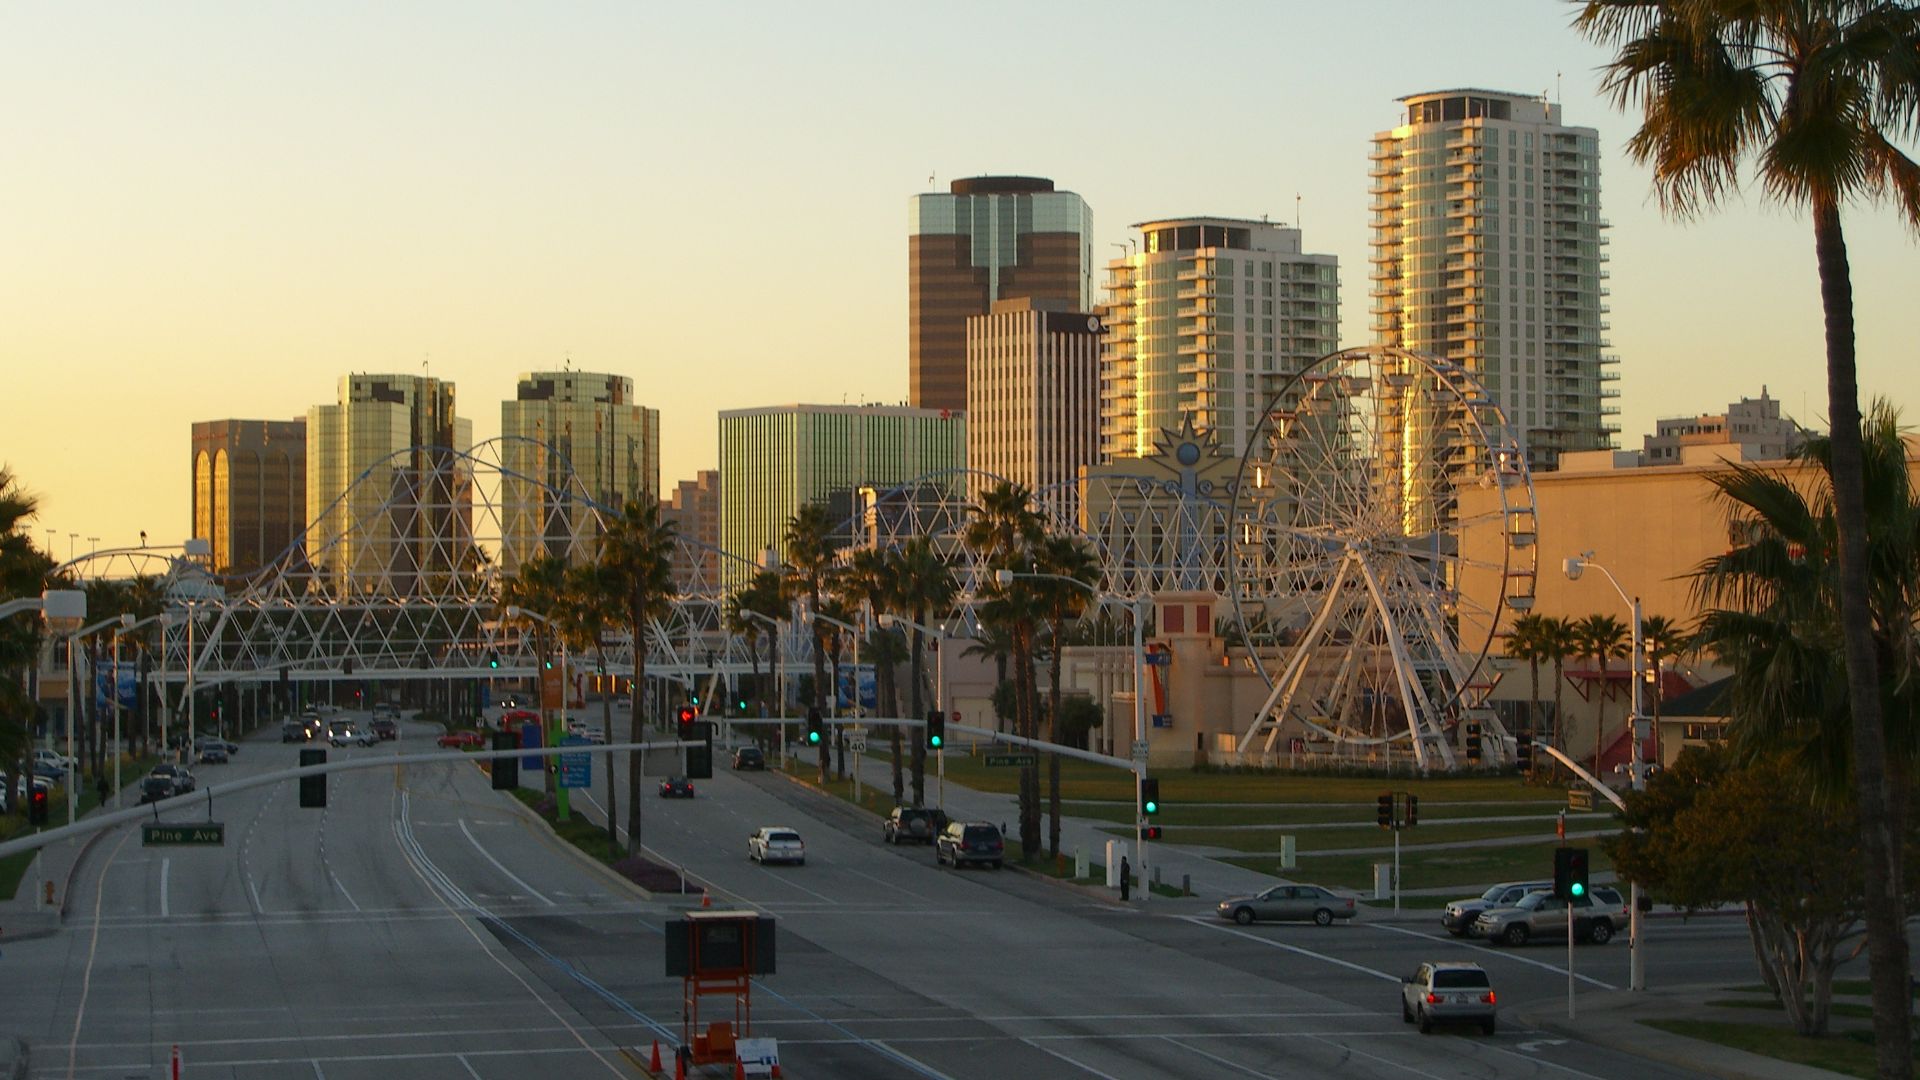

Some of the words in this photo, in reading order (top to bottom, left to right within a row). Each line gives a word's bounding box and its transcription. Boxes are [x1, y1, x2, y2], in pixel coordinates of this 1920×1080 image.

[851, 742, 865, 751] 40
[151, 829, 182, 841] Pine
[193, 829, 218, 841] Ave
